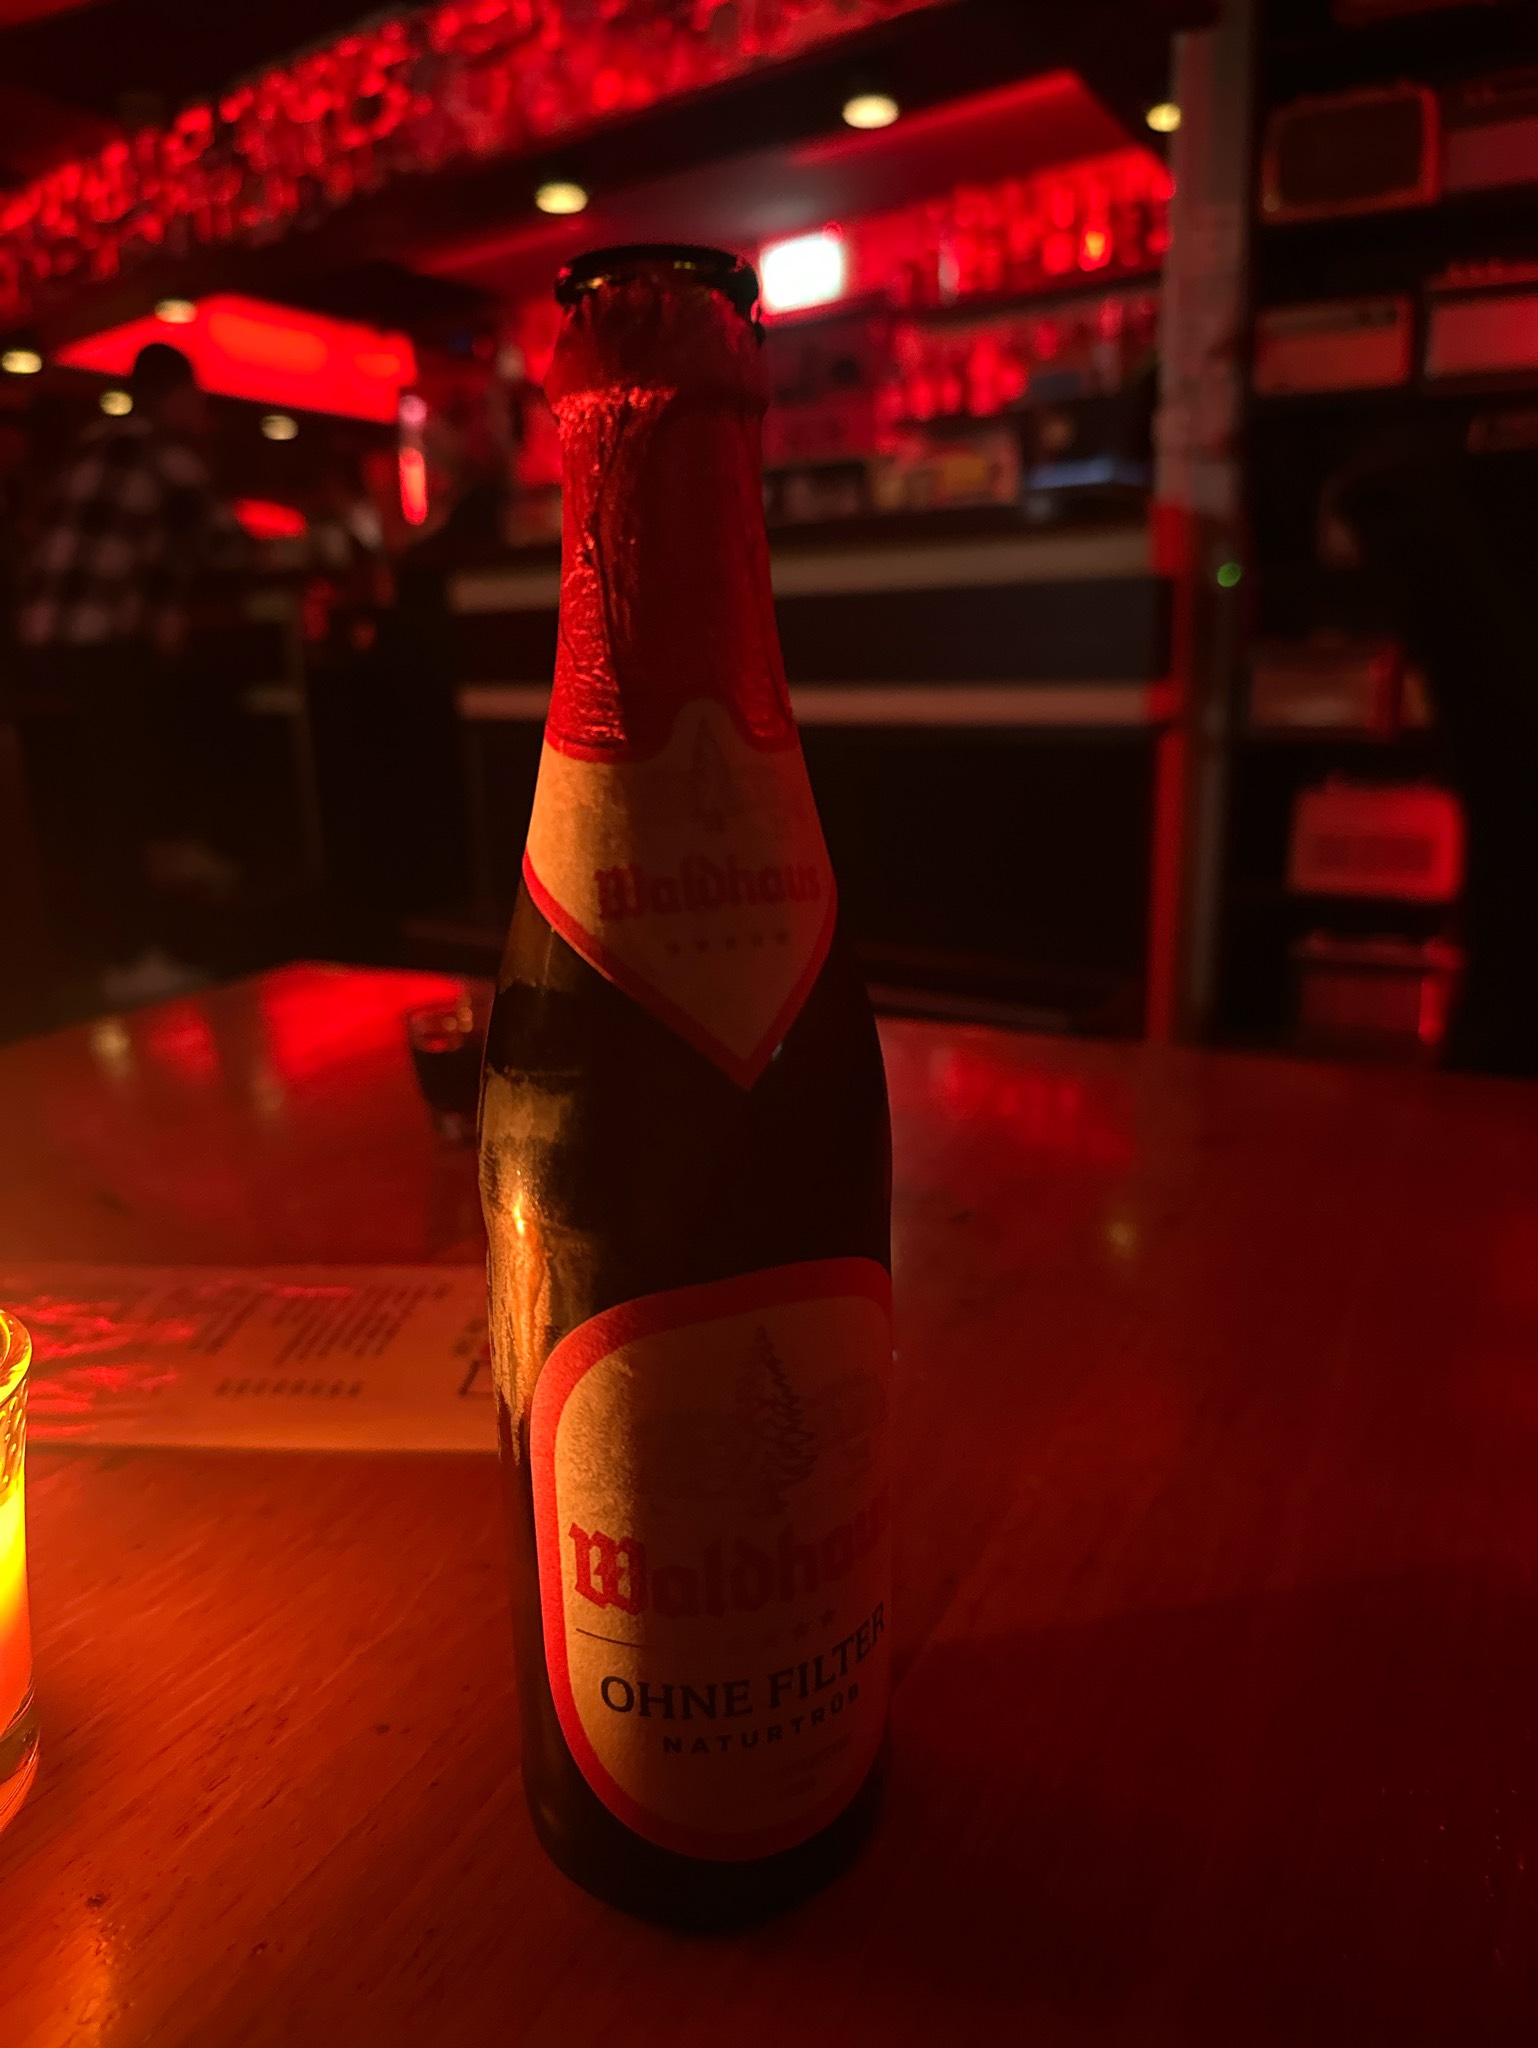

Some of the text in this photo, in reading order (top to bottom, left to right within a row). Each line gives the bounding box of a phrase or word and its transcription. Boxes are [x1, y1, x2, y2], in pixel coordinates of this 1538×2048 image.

[594, 854, 821, 921] Waldhaus
[601, 1601, 885, 1720] OHNE FILTER
